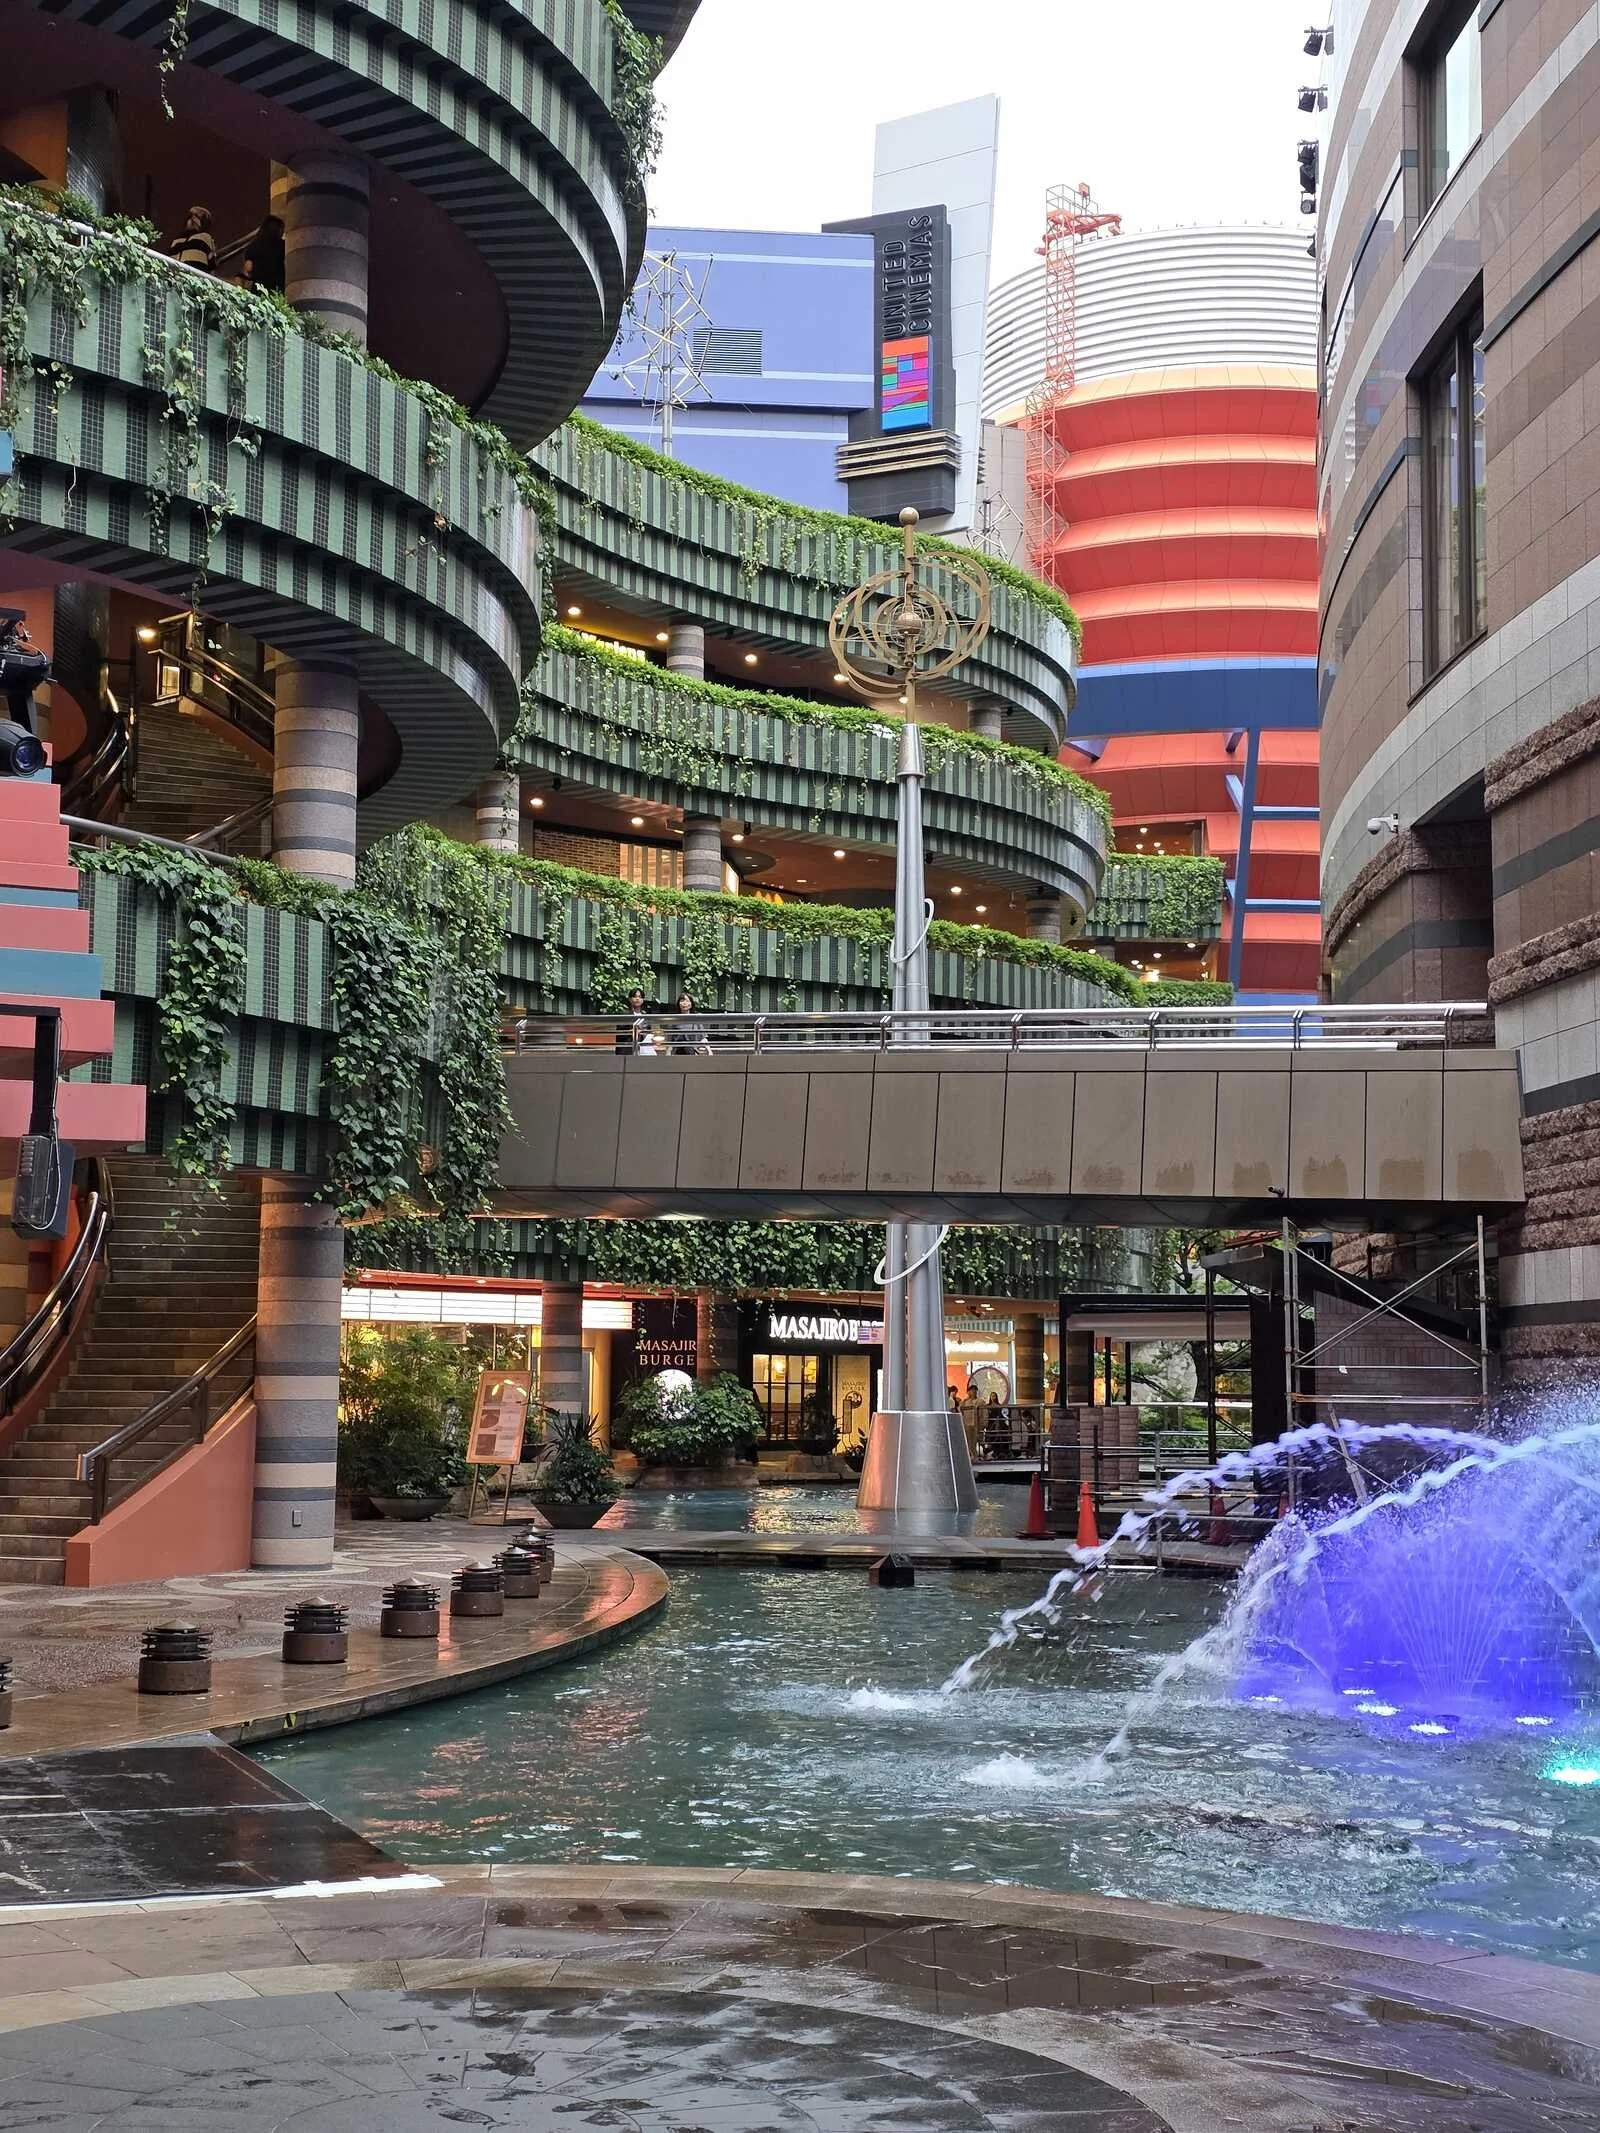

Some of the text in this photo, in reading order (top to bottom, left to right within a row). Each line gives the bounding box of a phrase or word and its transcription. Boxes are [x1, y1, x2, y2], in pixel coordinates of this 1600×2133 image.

[908, 215, 932, 333] CINEMAS
[883, 240, 906, 337] UNITED
[769, 1315, 849, 1341] MASAJIRO
[639, 1339, 697, 1351] MASAJIR
[639, 1354, 695, 1366] BURGE
